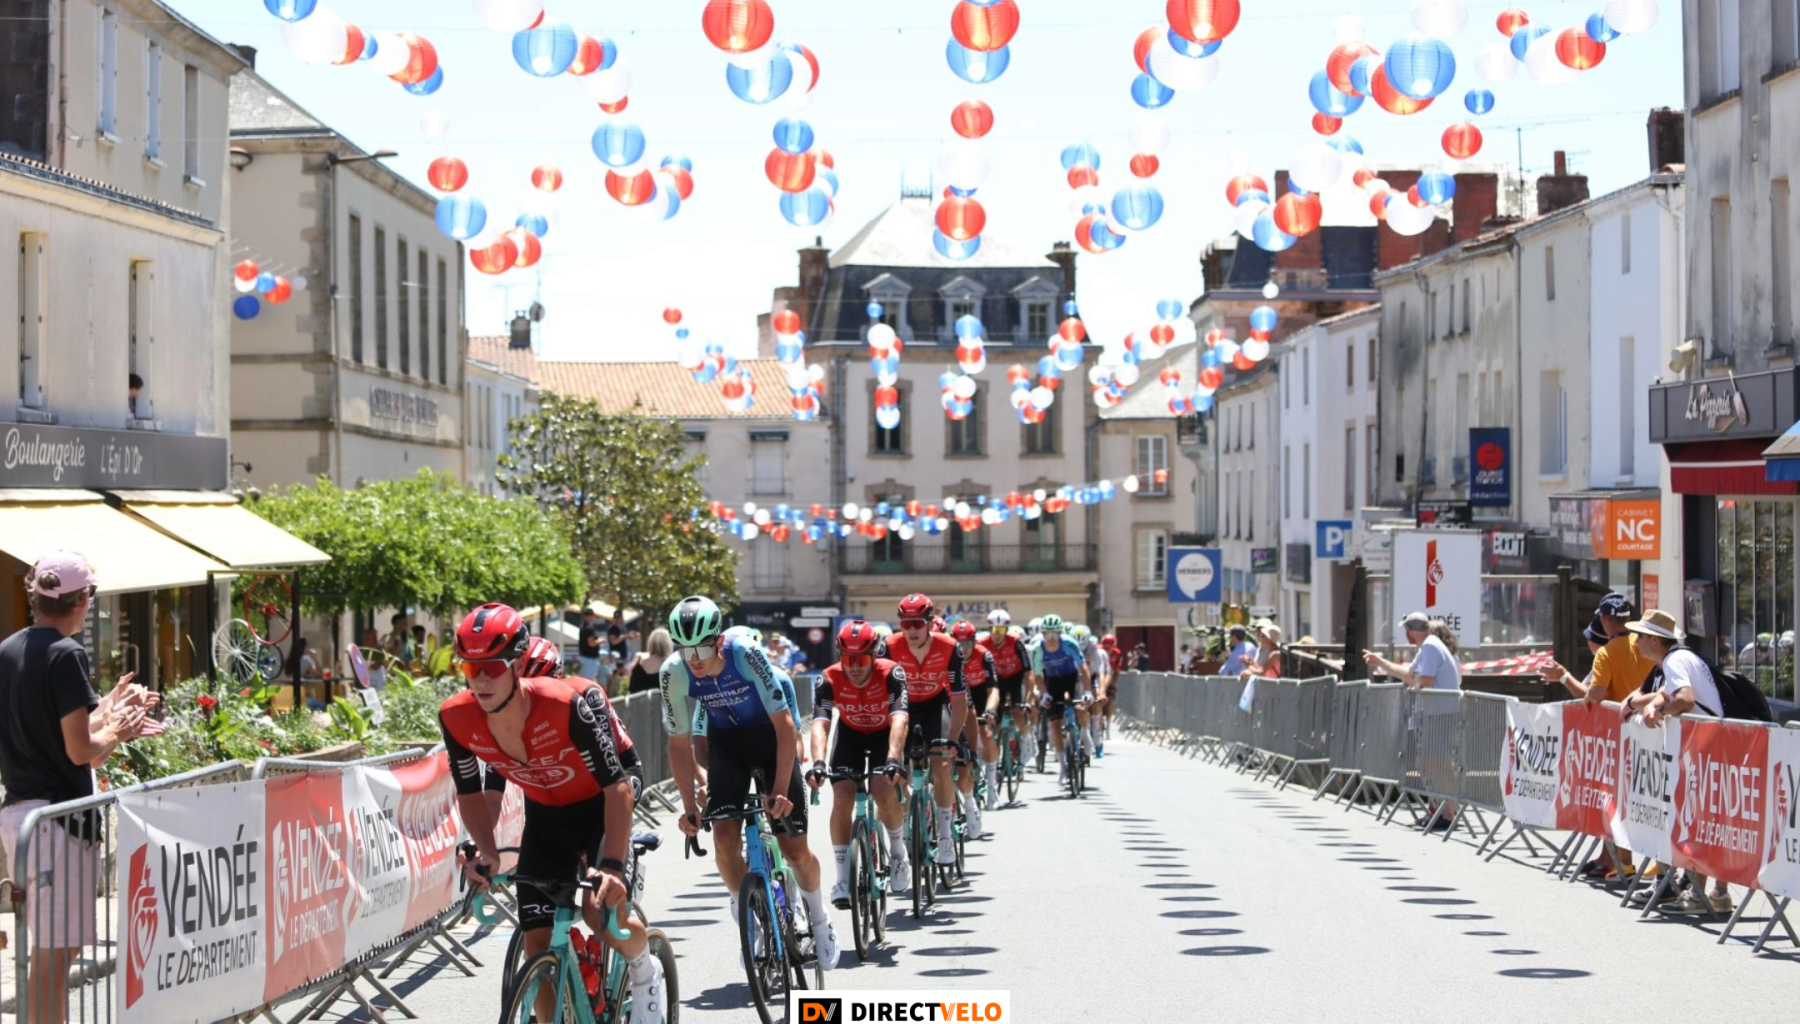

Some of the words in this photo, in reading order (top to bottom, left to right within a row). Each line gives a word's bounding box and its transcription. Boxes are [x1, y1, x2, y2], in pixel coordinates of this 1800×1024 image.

[5, 428, 86, 482] Boulangerie
[101, 436, 122, 482] L'Épi
[124, 445, 143, 475] D'Or
[1475, 474, 1504, 485] france
[1471, 491, 1509, 499] rédaction
[1617, 508, 1654, 517] CABINET
[1325, 526, 1344, 553] P
[1616, 518, 1656, 541] NC
[1617, 543, 1654, 551] COURTAGE
[956, 601, 1009, 614] AXELIS
[743, 652, 774, 692] MONDIALE
[905, 670, 948, 681] RKEA
[704, 685, 750, 701] DECATHLON
[834, 701, 890, 713] ARKEA
[490, 747, 576, 769] RKEA
[592, 727, 620, 777] ARKEA
[1513, 725, 1559, 777] VENDÉE
[1698, 753, 1761, 822] VENDÉE
[357, 794, 405, 879] VENDÉE
[1694, 818, 1705, 844] LE
[1704, 816, 1759, 855] DÉPARTEMENT
[287, 806, 345, 904] VENDÉE
[1785, 838, 1797, 865] LE
[160, 824, 258, 938] VENDÉE
[290, 915, 299, 949] LE
[157, 951, 176, 991] LE
[176, 930, 258, 986] DÉPARTEMENT
